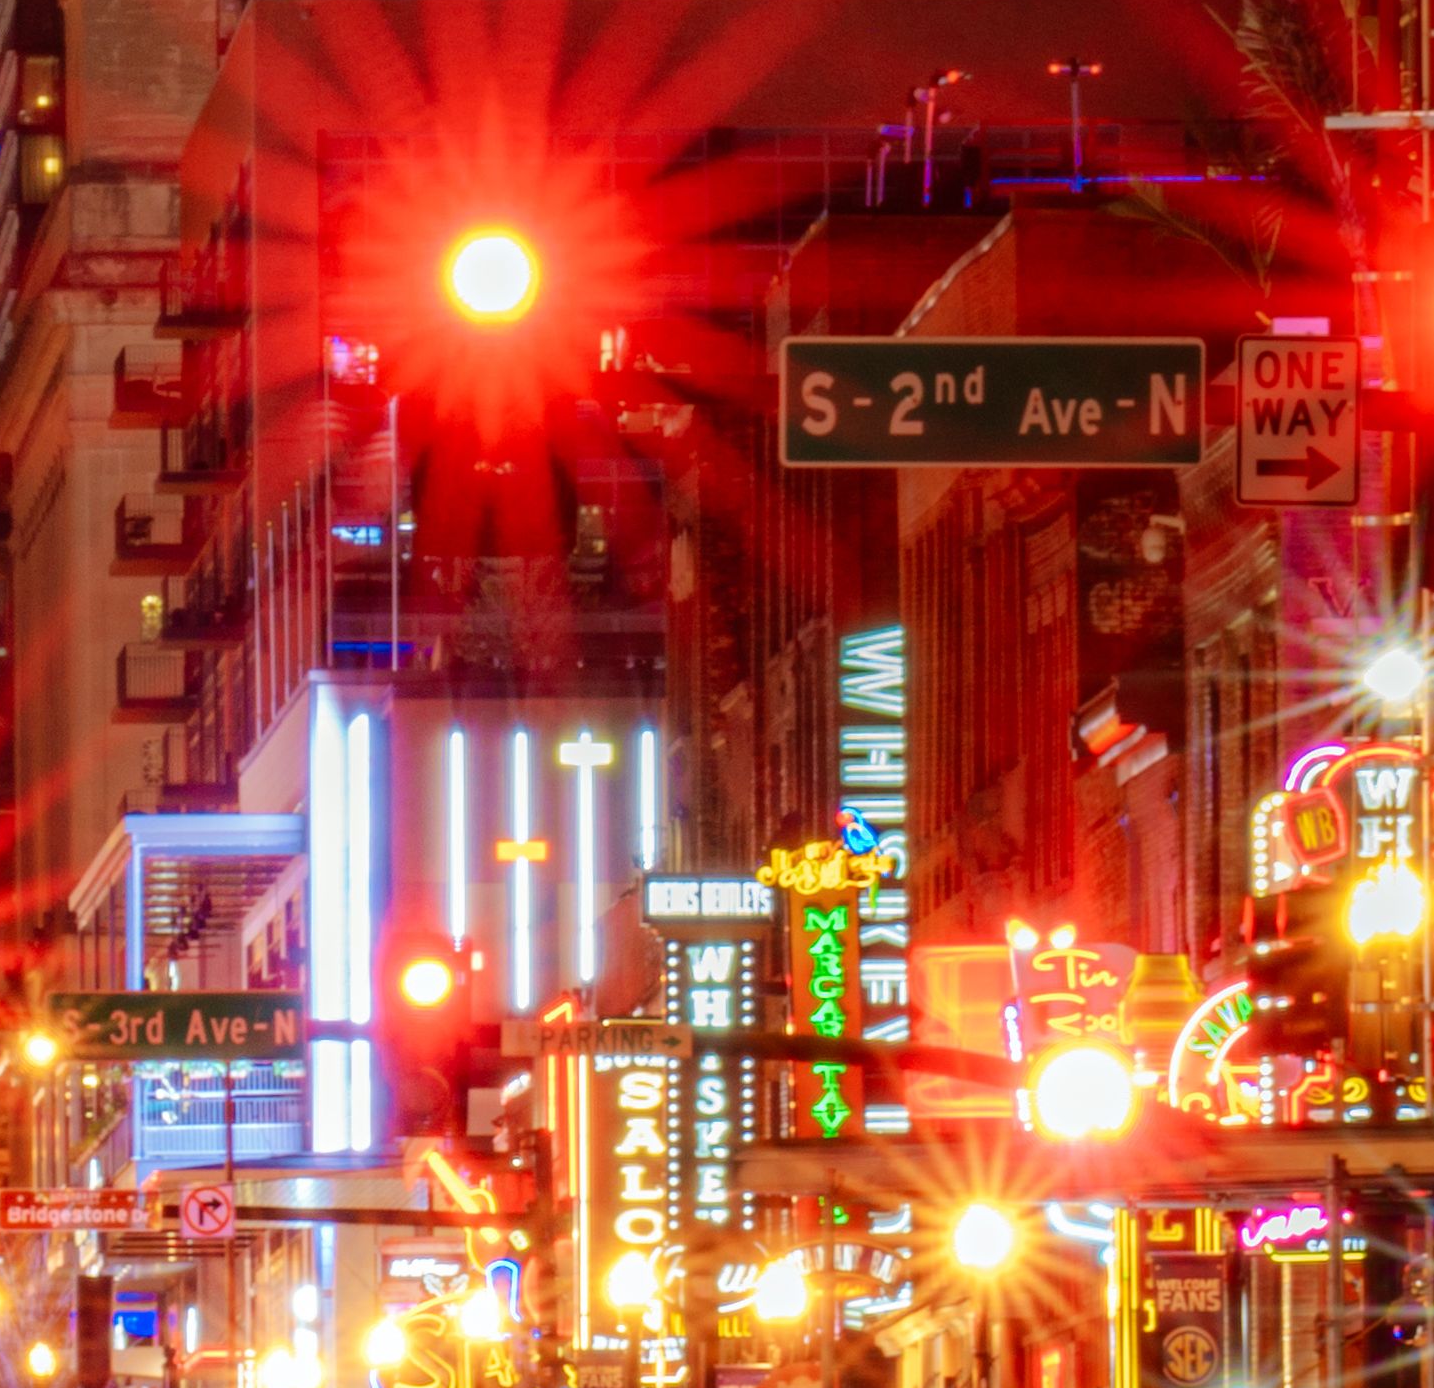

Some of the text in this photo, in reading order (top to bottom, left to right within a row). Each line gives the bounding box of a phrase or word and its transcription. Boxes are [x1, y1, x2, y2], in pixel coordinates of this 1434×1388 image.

[1255, 350, 1345, 391] ONE
[1252, 399, 1348, 437] WAY
[1032, 948, 1118, 990] Tin
[540, 1027, 654, 1053] PARKING
[7, 1204, 129, 1229] Bridgestone
[1155, 1277, 1221, 1292] WELCOME
[1156, 1291, 1223, 1313] FANS
